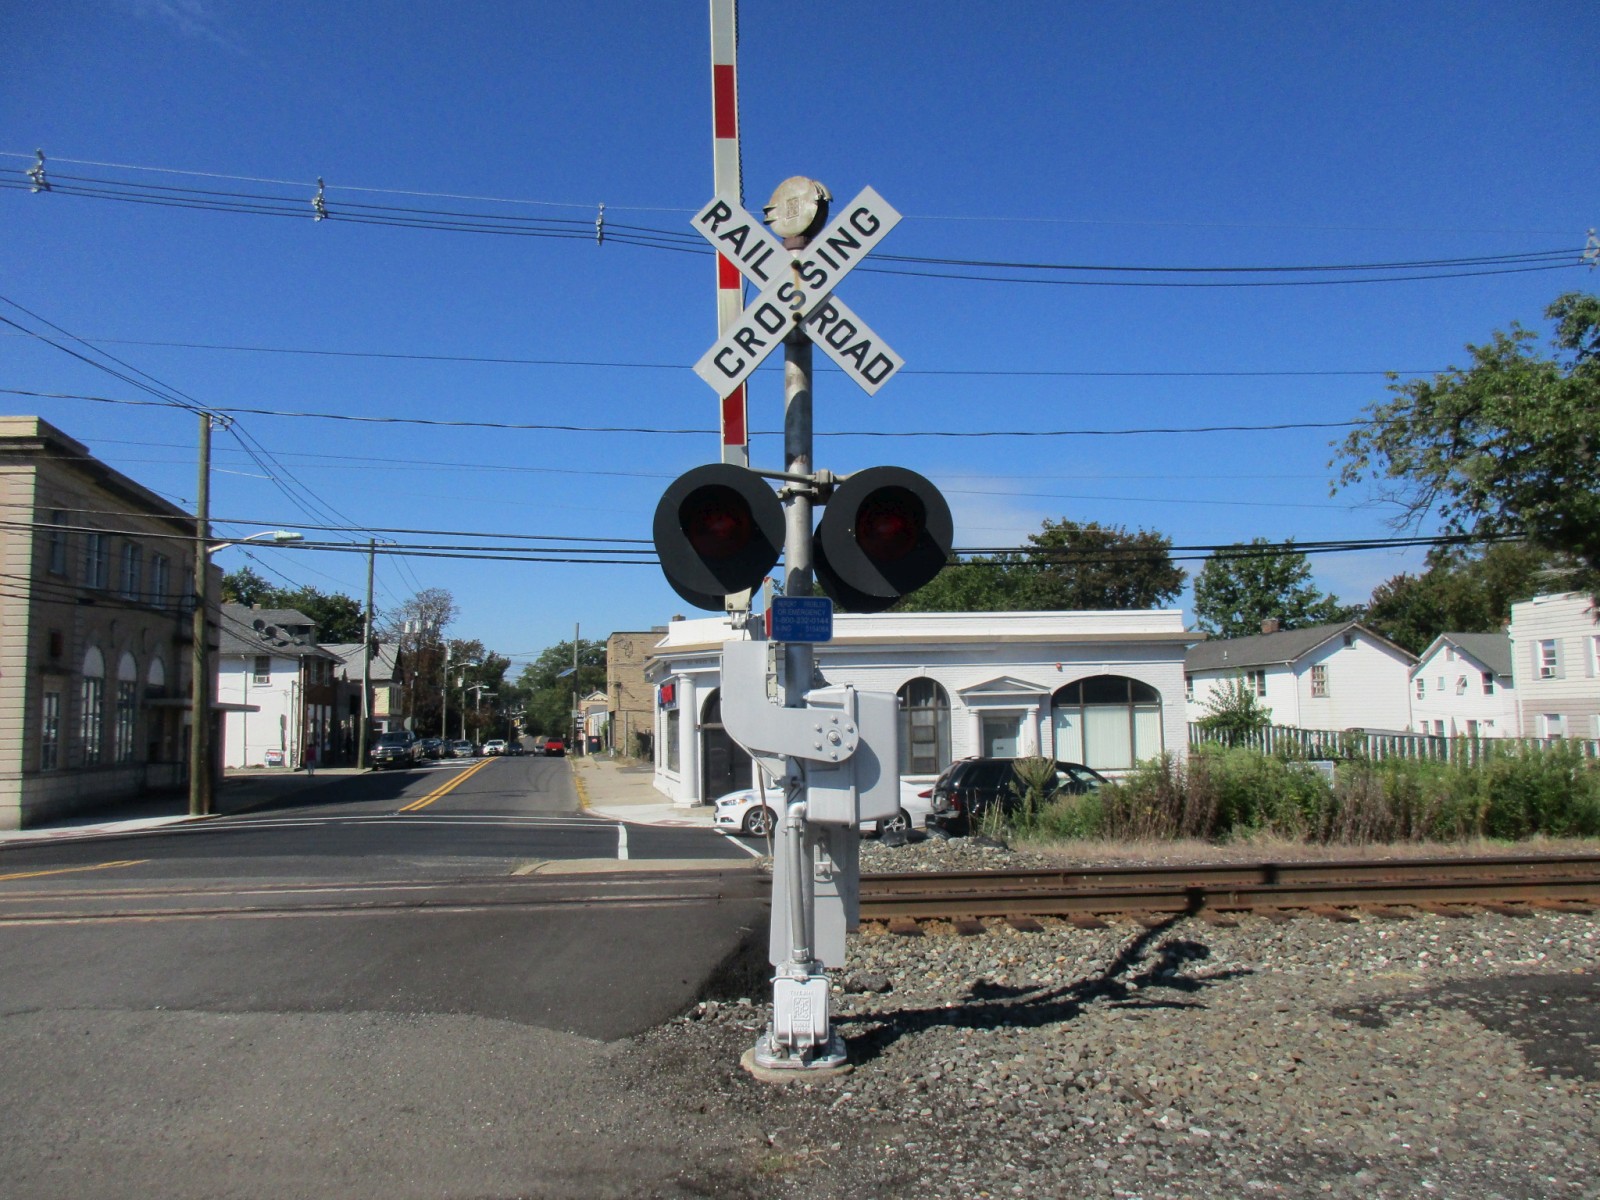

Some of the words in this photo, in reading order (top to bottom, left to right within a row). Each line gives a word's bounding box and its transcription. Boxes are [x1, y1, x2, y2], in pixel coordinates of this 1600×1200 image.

[700, 200, 774, 282] RAIL
[806, 302, 894, 385] ROAD
[713, 207, 880, 379] CROSSING
[788, 608, 826, 616] EMERGENCY
